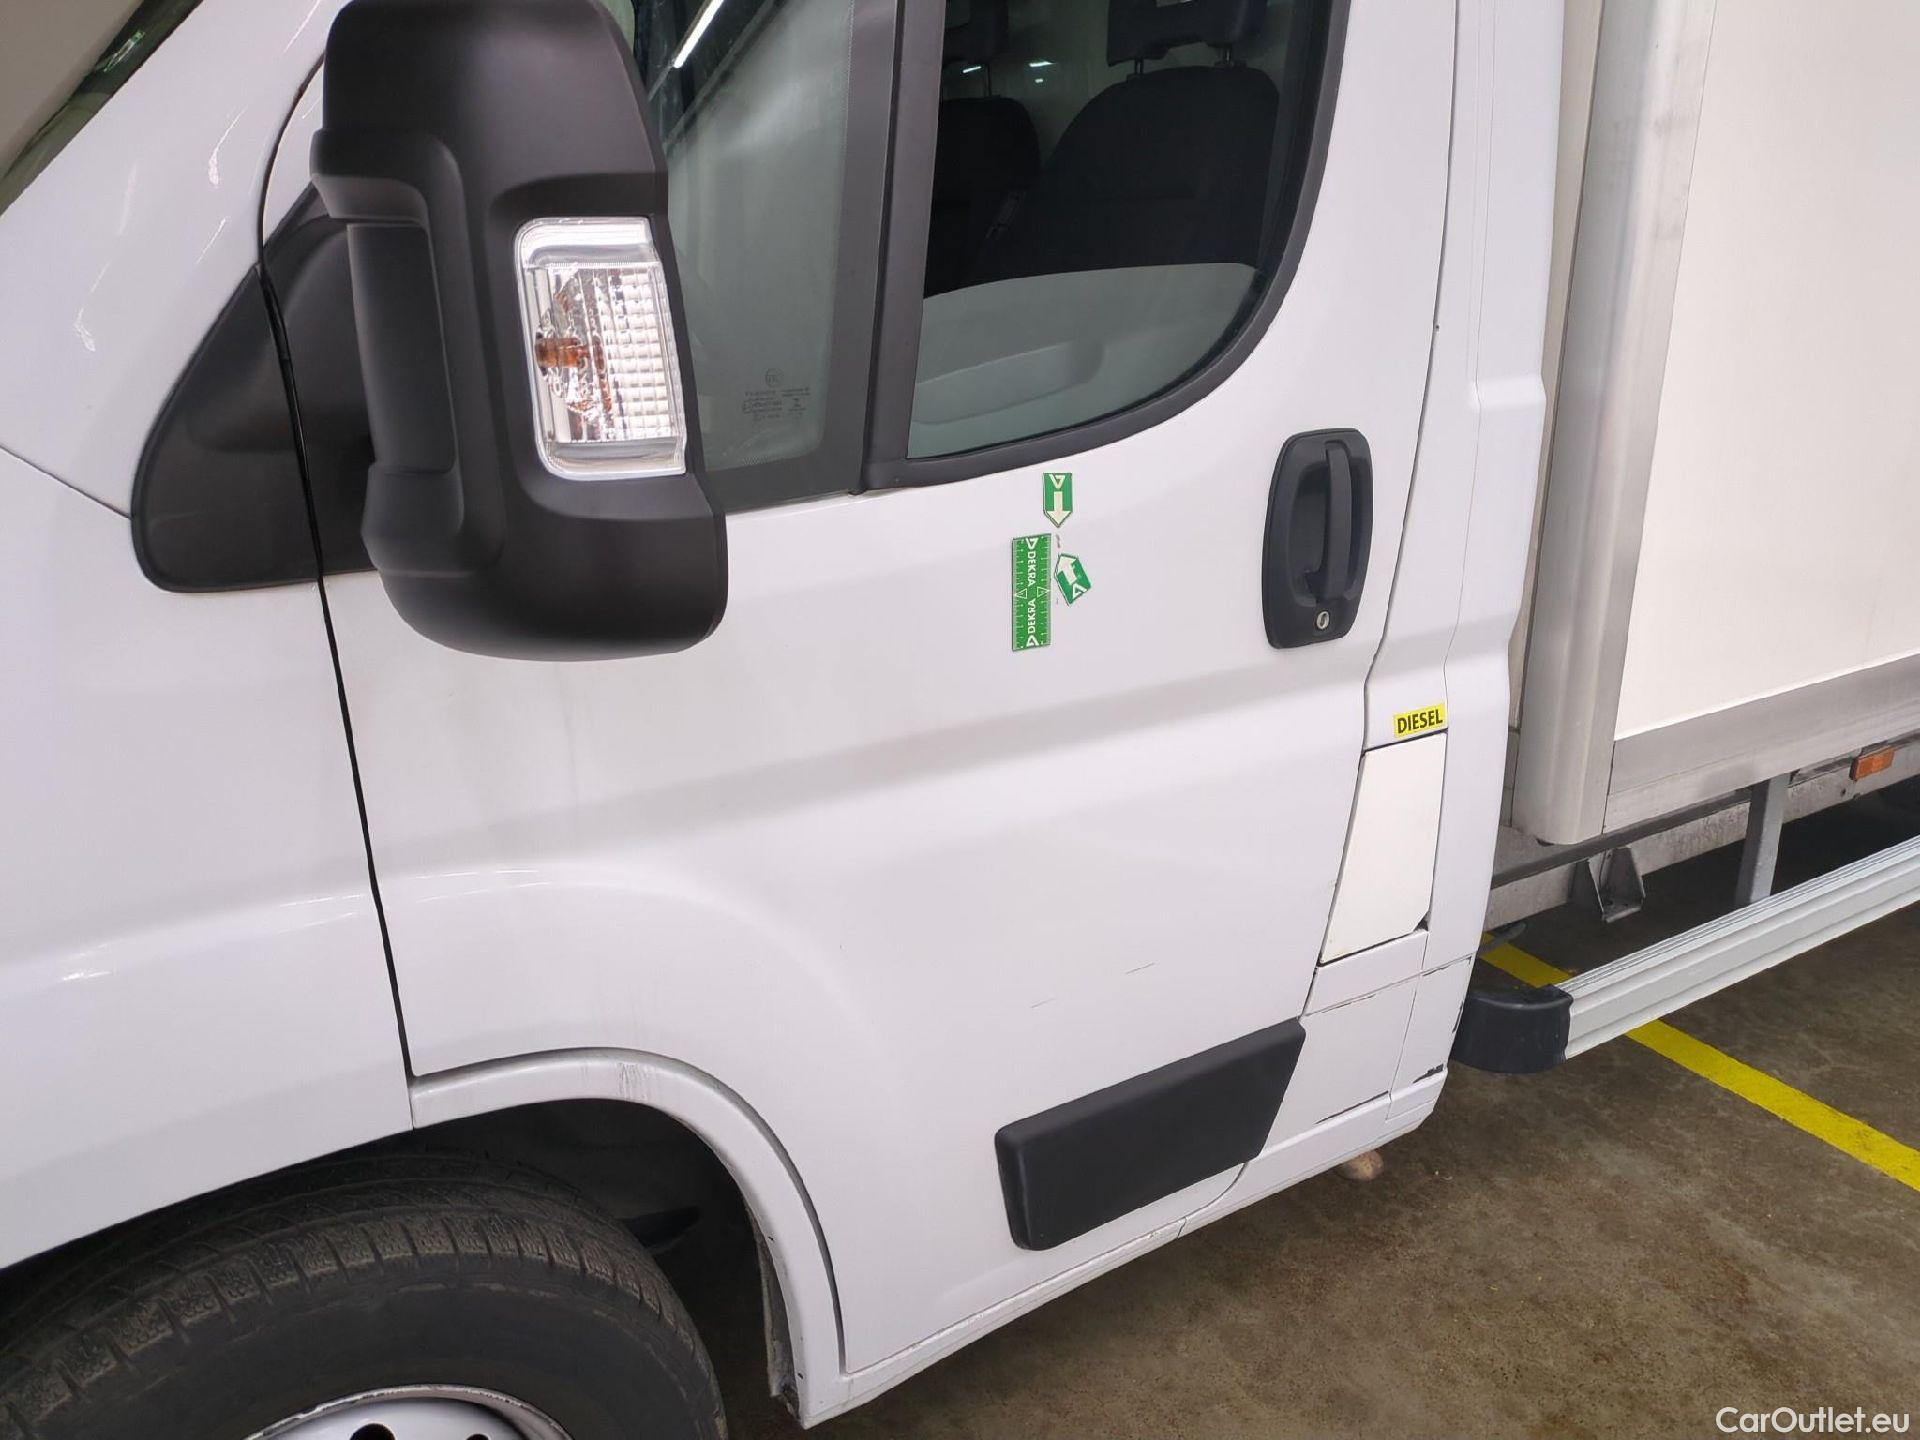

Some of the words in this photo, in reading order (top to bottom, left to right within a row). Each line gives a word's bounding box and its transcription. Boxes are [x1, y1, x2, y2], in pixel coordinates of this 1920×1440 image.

[1027, 551, 1036, 587] DEKRA
[1027, 598, 1036, 634] DEKRA
[1397, 709, 1443, 734] DIESEL
